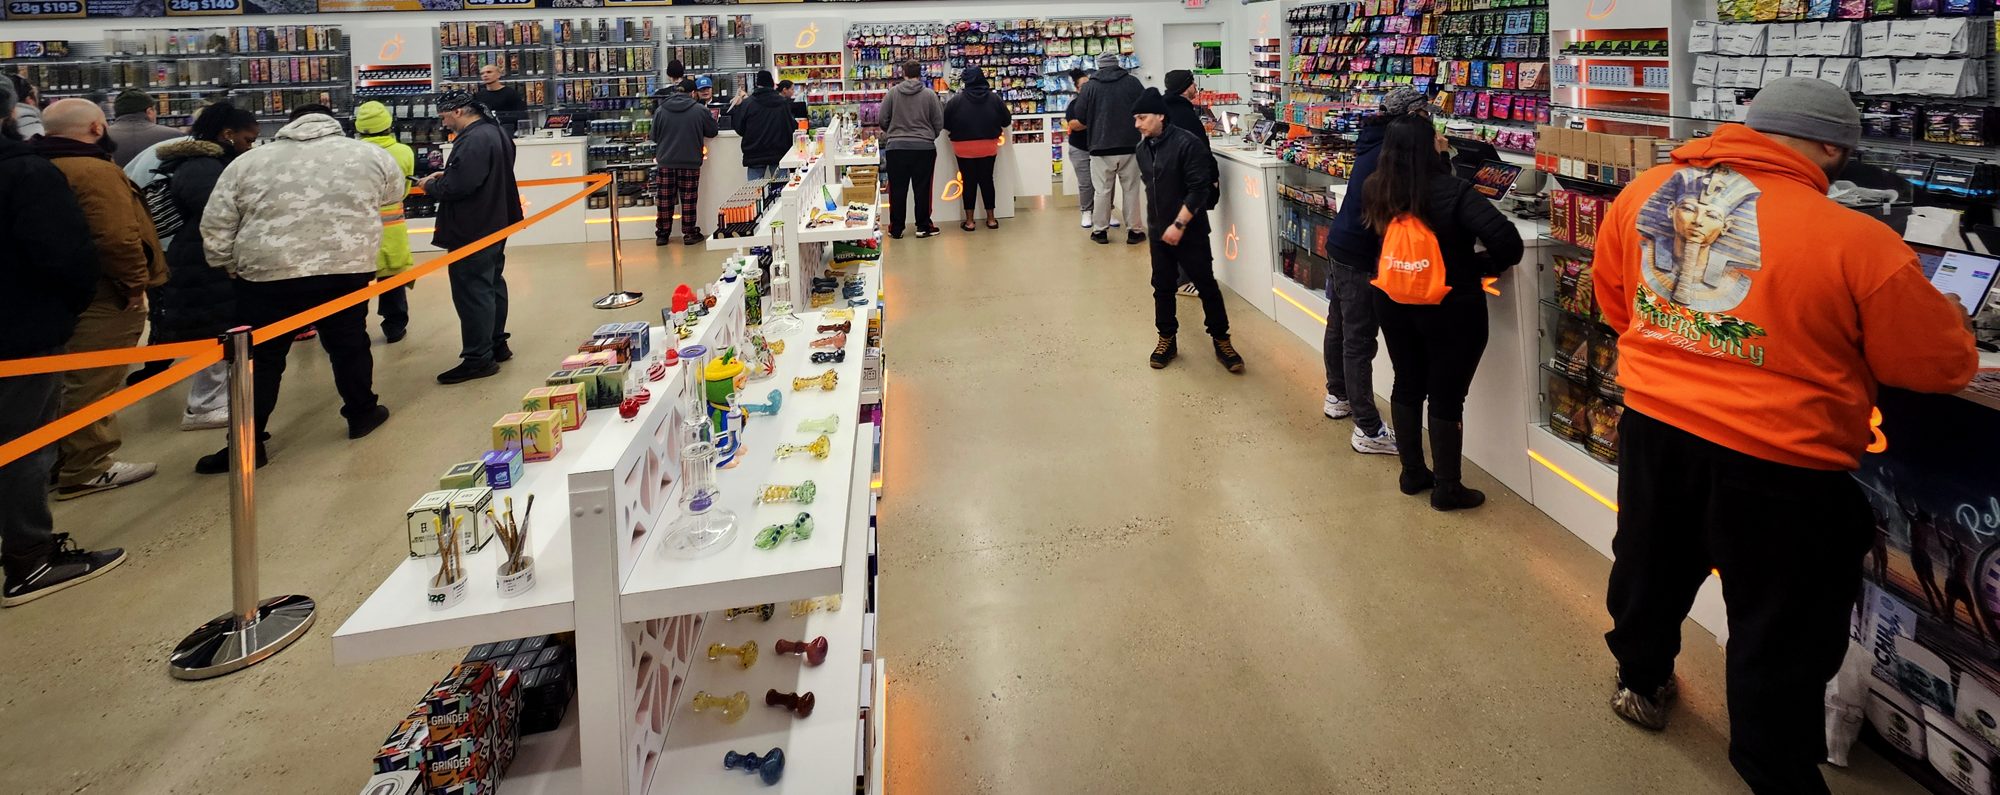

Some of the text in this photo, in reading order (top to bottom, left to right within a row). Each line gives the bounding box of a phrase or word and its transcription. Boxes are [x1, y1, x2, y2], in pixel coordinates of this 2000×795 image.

[10, 2, 79, 14] 28g $195
[171, 0, 235, 10] 28g $140
[551, 150, 572, 167] 21
[1956, 496, 2000, 544] Rel
[431, 712, 470, 726] GRINDER
[431, 757, 471, 772] GRINDER
